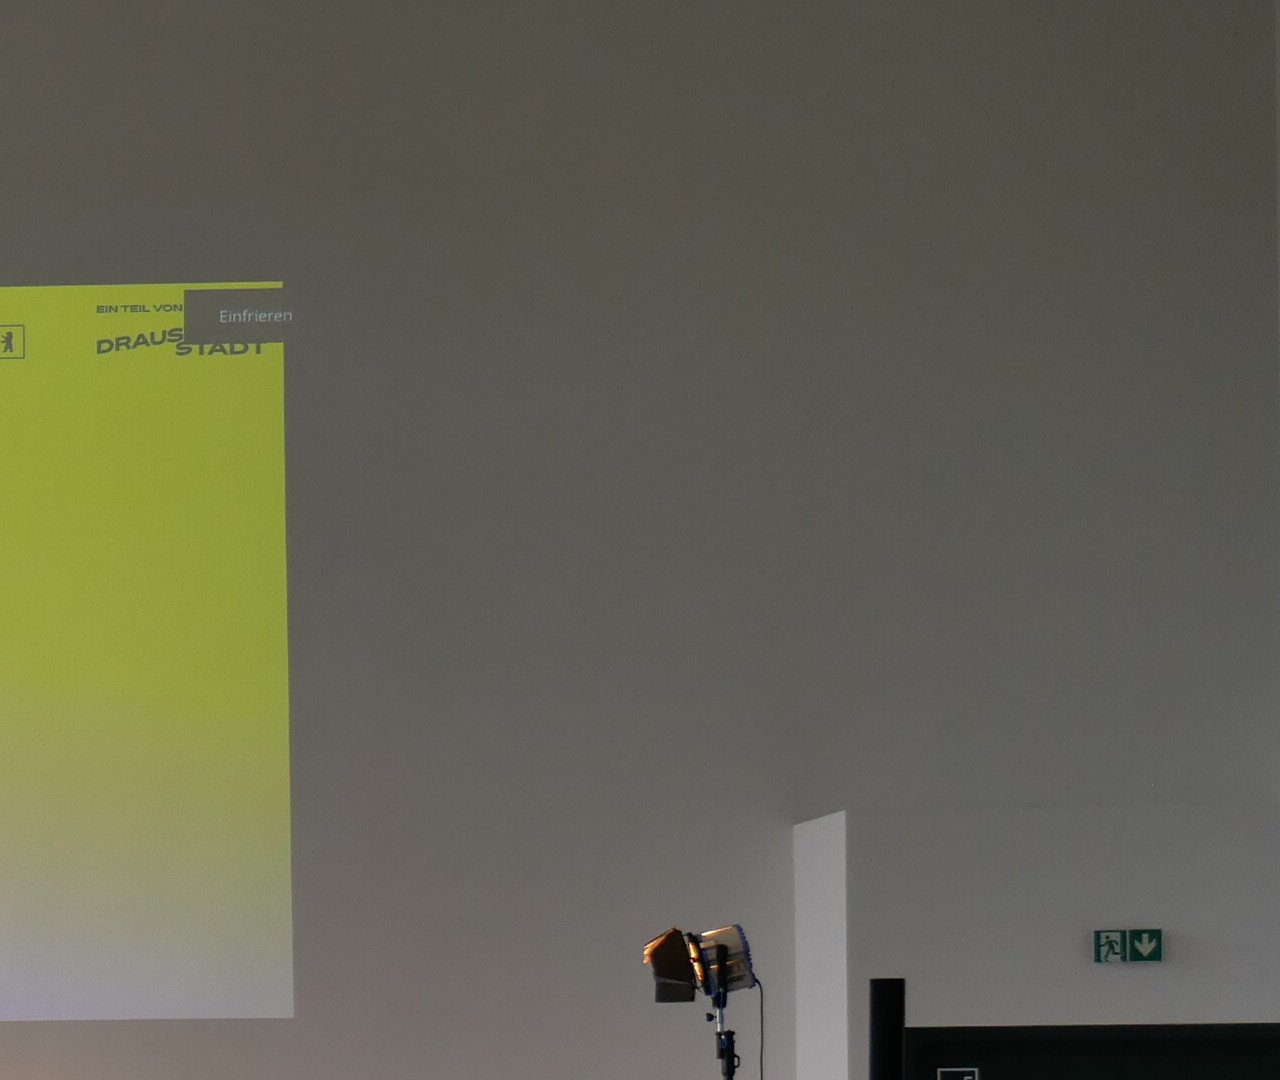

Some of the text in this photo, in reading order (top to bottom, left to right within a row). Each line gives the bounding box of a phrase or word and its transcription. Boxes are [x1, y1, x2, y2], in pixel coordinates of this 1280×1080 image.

[96, 304, 183, 314] EIN TEIL VON
[220, 309, 293, 324] Einfrieren
